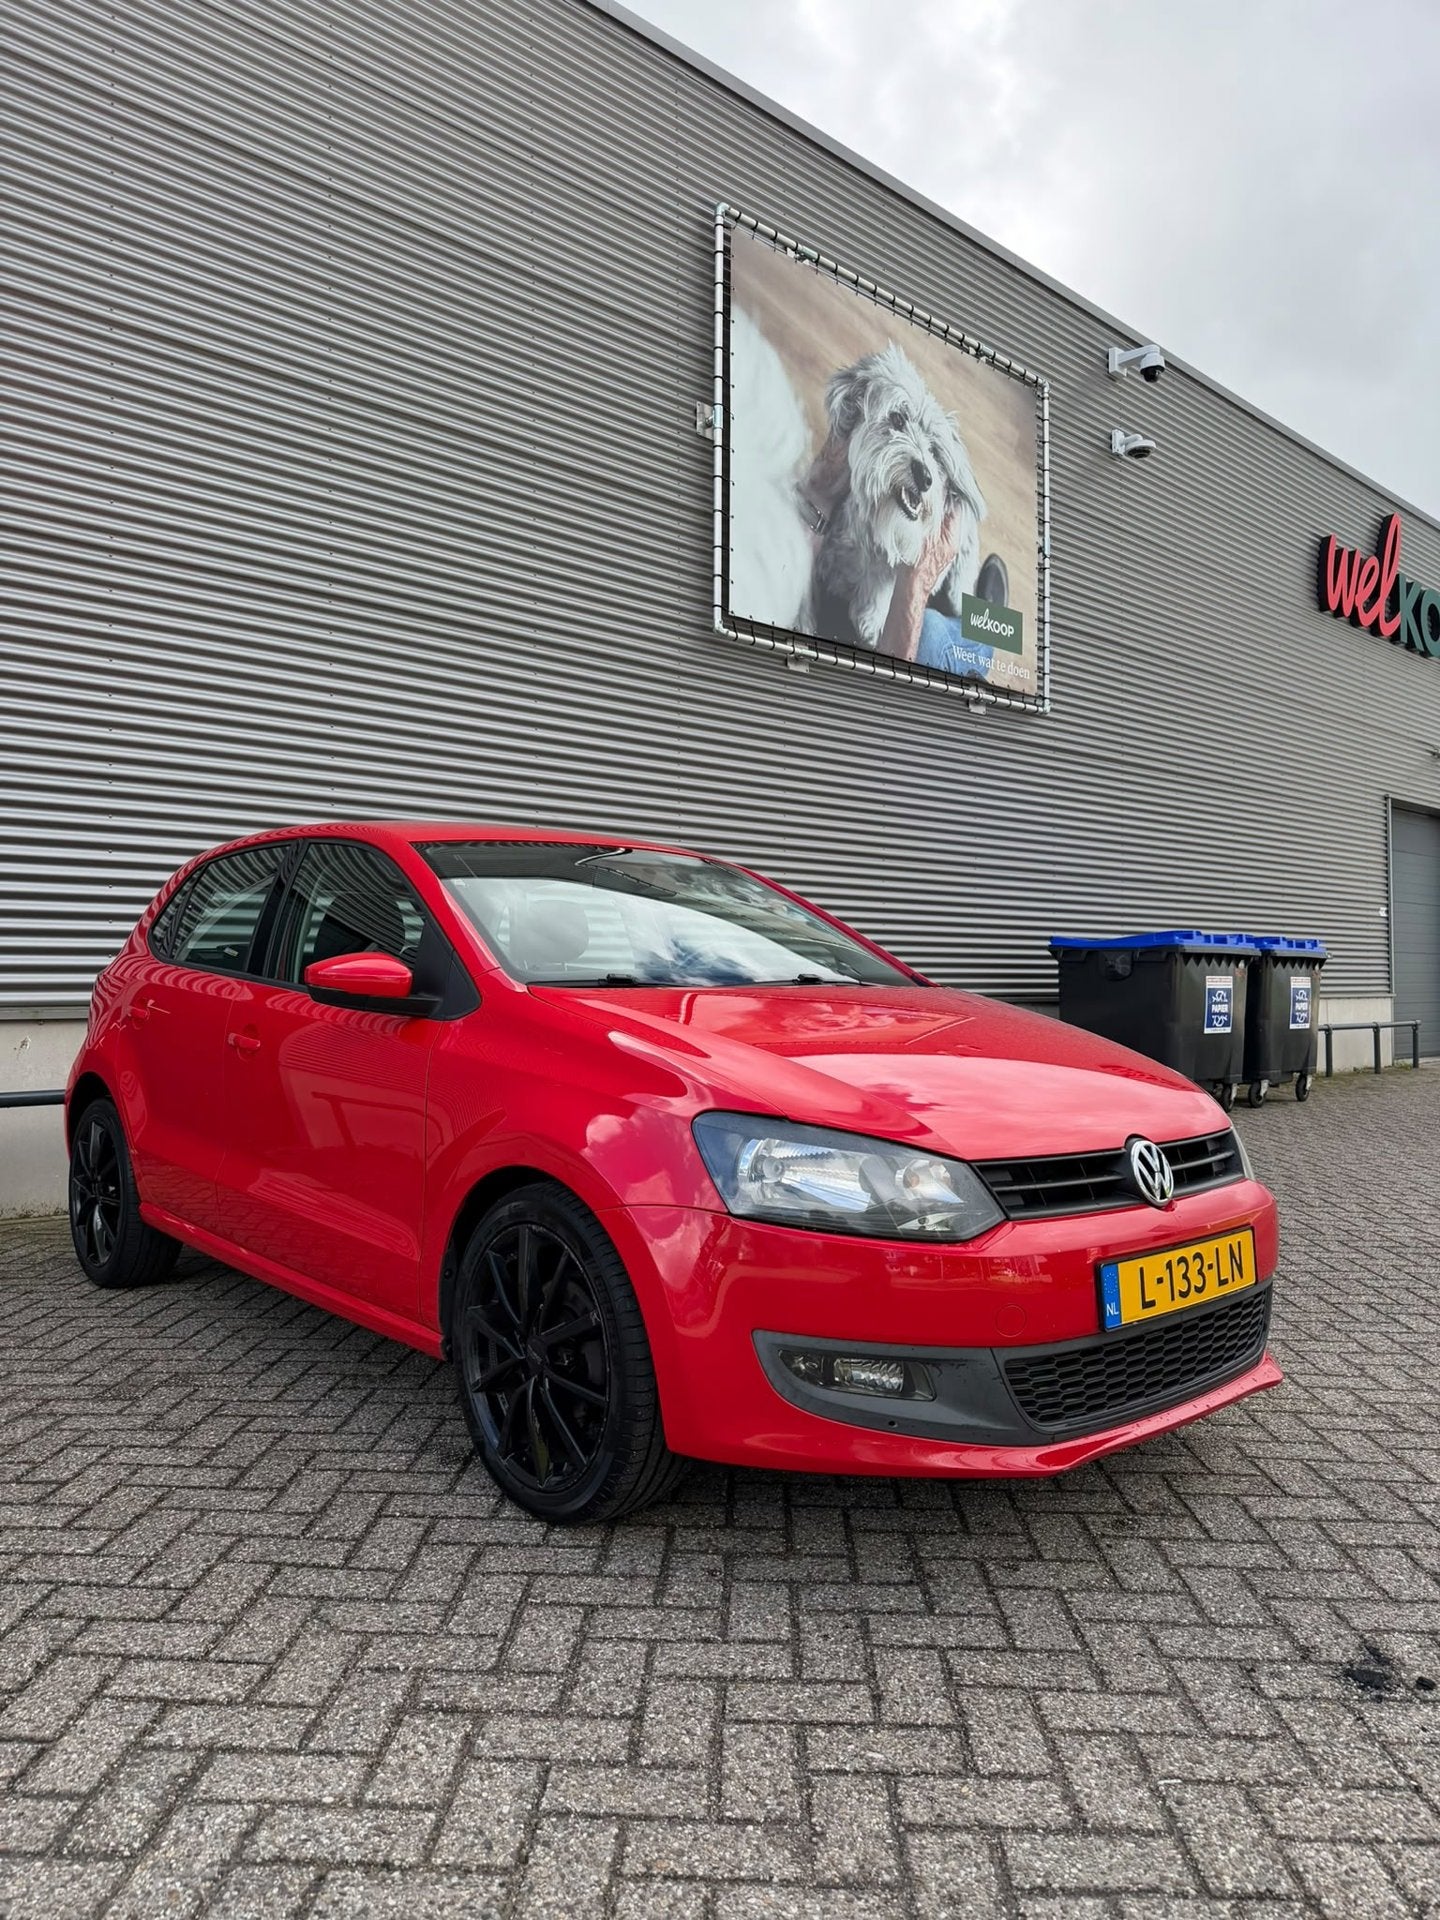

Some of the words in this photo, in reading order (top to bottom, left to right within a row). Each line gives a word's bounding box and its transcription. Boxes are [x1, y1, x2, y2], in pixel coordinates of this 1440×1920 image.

[952, 645, 976, 664] Weet
[978, 654, 995, 668] wat
[996, 659, 1006, 672] te
[1007, 661, 1030, 679] doen
[1211, 1004, 1229, 1013] PAPIER
[1139, 1240, 1244, 1310] L-133-LN
[1106, 1302, 1119, 1317] NL
